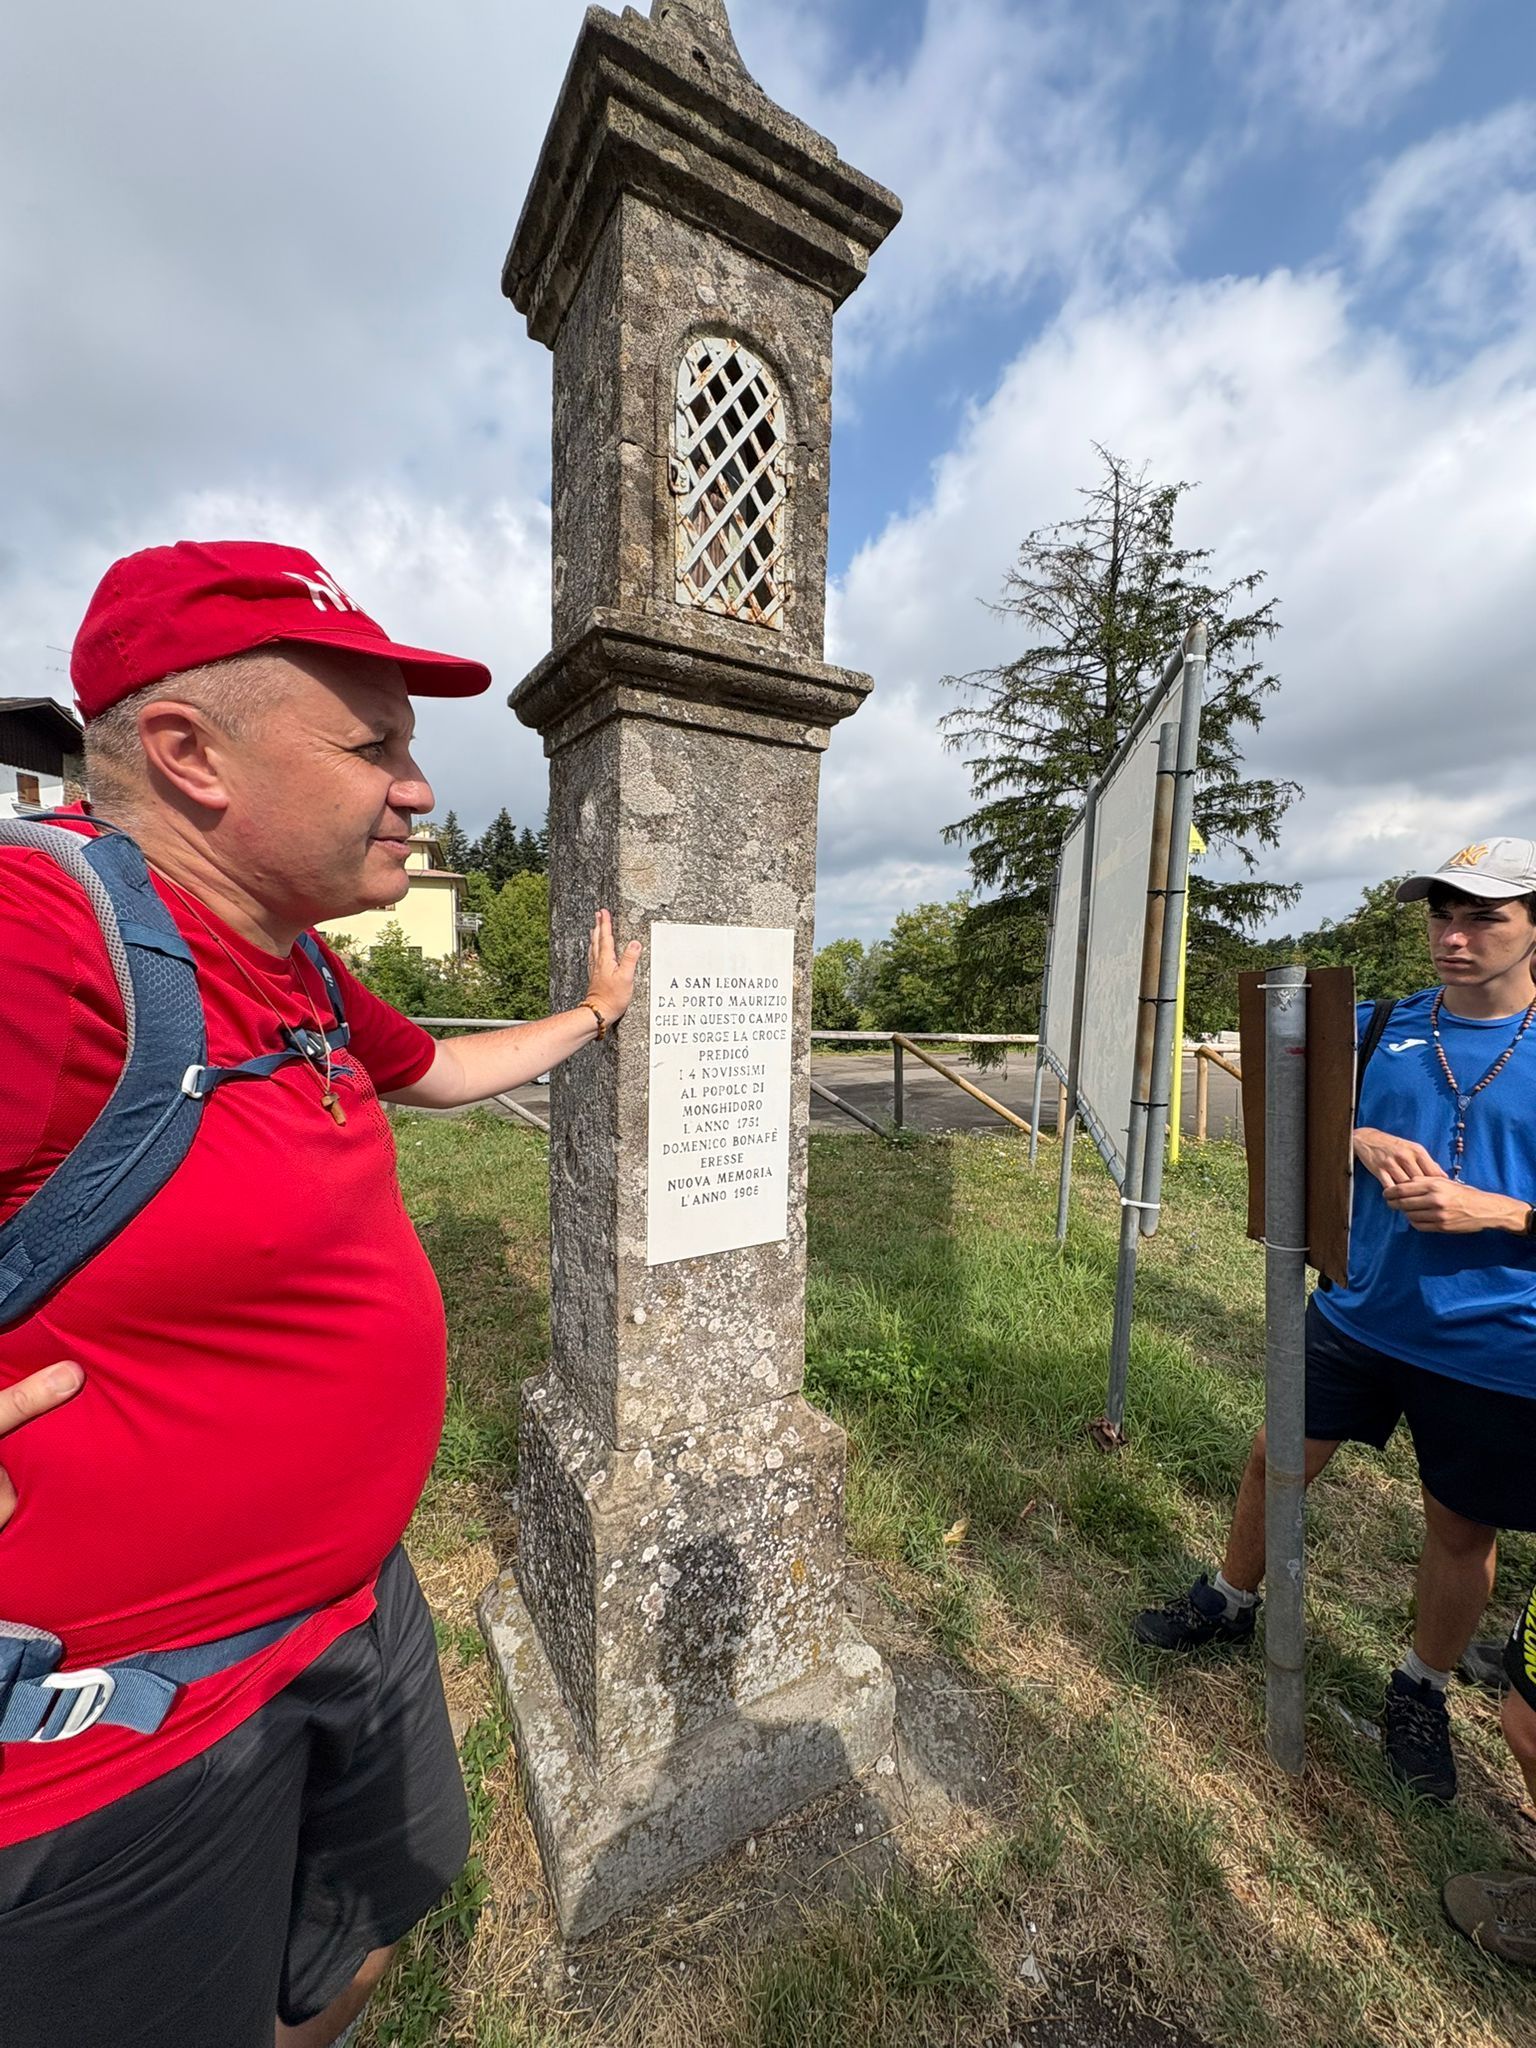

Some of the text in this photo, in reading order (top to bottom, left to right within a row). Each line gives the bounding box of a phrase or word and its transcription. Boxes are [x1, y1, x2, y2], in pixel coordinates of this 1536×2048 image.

[669, 977, 779, 989] A SAN LEONARDO
[657, 995, 788, 1008] DA PORTO MAURIZIO
[655, 1012, 788, 1027] CHE IN QUESTO CAMPO
[654, 1029, 787, 1045] DOVE SORGE LA CROCE
[688, 1068, 696, 1080] 4
[702, 1064, 765, 1080] NOVISSIMI
[680, 1082, 764, 1100] AL POPOLO DI
[682, 1100, 763, 1117] MONGHIDORO
[737, 1117, 759, 1129] 1751
[662, 1128, 778, 1155] DOMENICO BONAFÈ
[700, 1152, 744, 1169] ERESSE
[667, 1166, 773, 1191] NUOVA MEMORIA
[681, 1190, 727, 1207] L'ANNO
